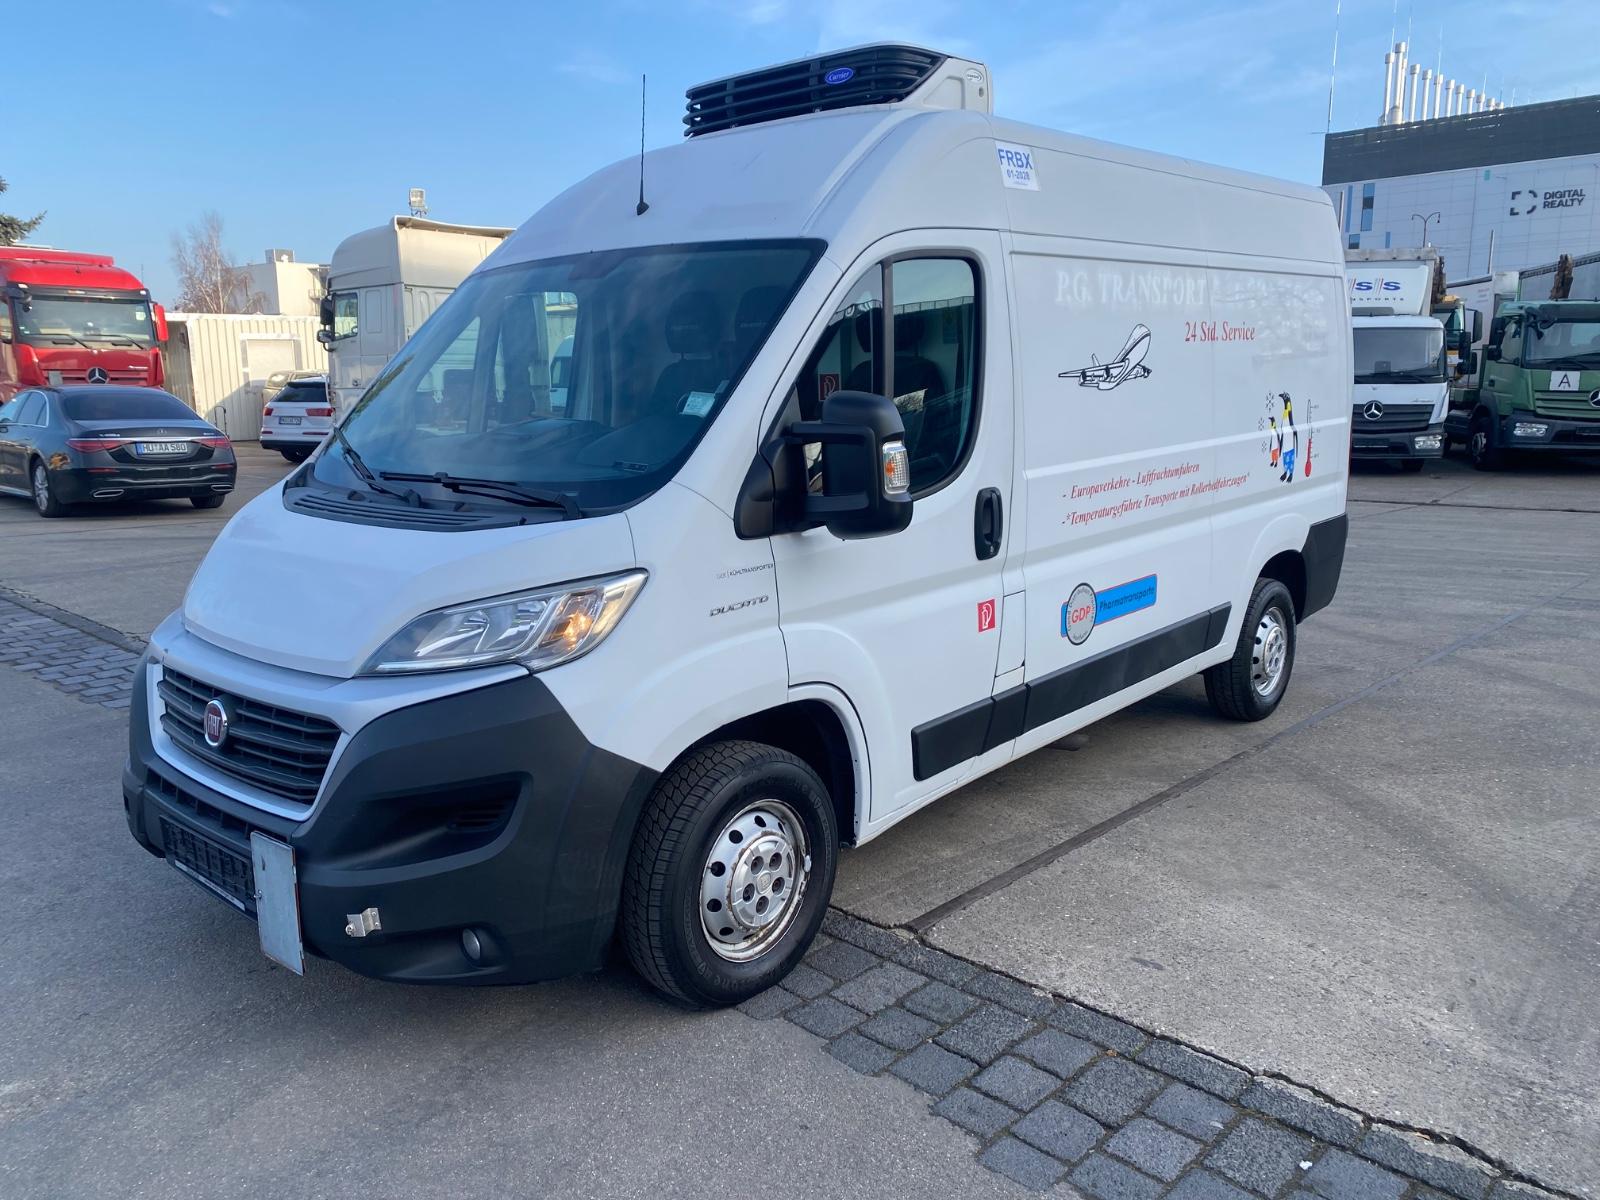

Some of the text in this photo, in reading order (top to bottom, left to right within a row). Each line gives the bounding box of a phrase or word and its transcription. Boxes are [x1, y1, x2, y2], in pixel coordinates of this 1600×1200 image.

[997, 148, 1033, 170] FRBX
[1542, 197, 1585, 209] REALTY
[1543, 188, 1586, 200] DIGITAL
[1098, 272, 1208, 306] TRANSPORT
[1184, 320, 1256, 342] 24 Std. Service
[1557, 373, 1572, 389] A
[1070, 475, 1131, 500] Europaverkehre
[1144, 490, 1180, 507] Transporte
[1179, 485, 1191, 498] mit
[709, 595, 769, 617] DUCATO
[1100, 586, 1155, 611] Pharmatransporte
[1071, 605, 1092, 624] GDP
[207, 713, 221, 737] FIAT
